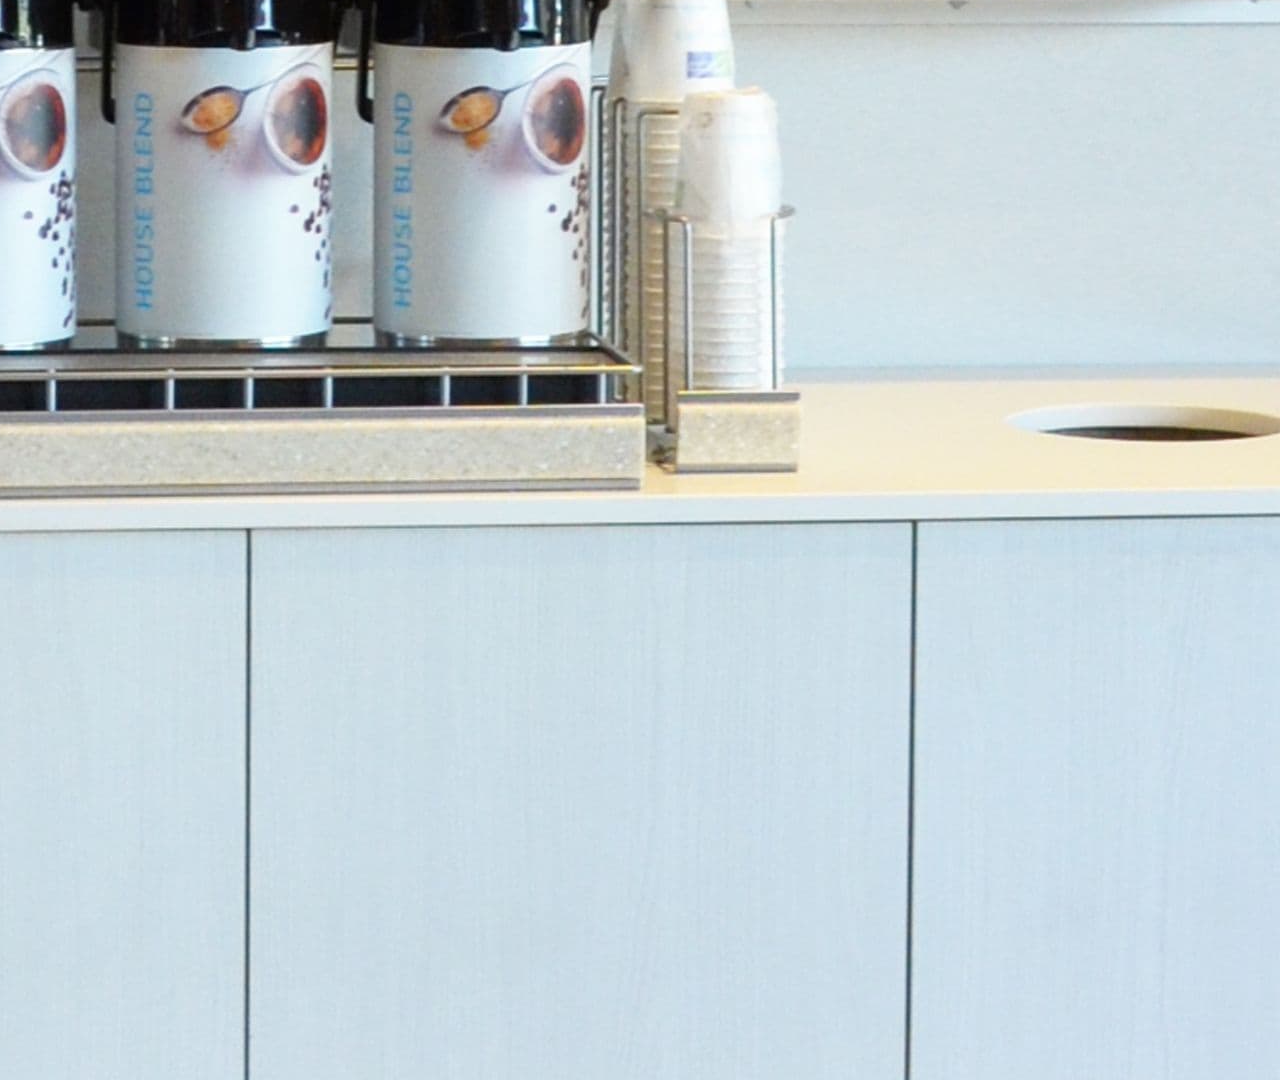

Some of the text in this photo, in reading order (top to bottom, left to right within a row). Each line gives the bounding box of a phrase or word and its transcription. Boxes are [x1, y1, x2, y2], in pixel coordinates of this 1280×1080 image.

[134, 93, 154, 309] HOUSE BLEND
[393, 92, 413, 307] HOUSE BLEND
